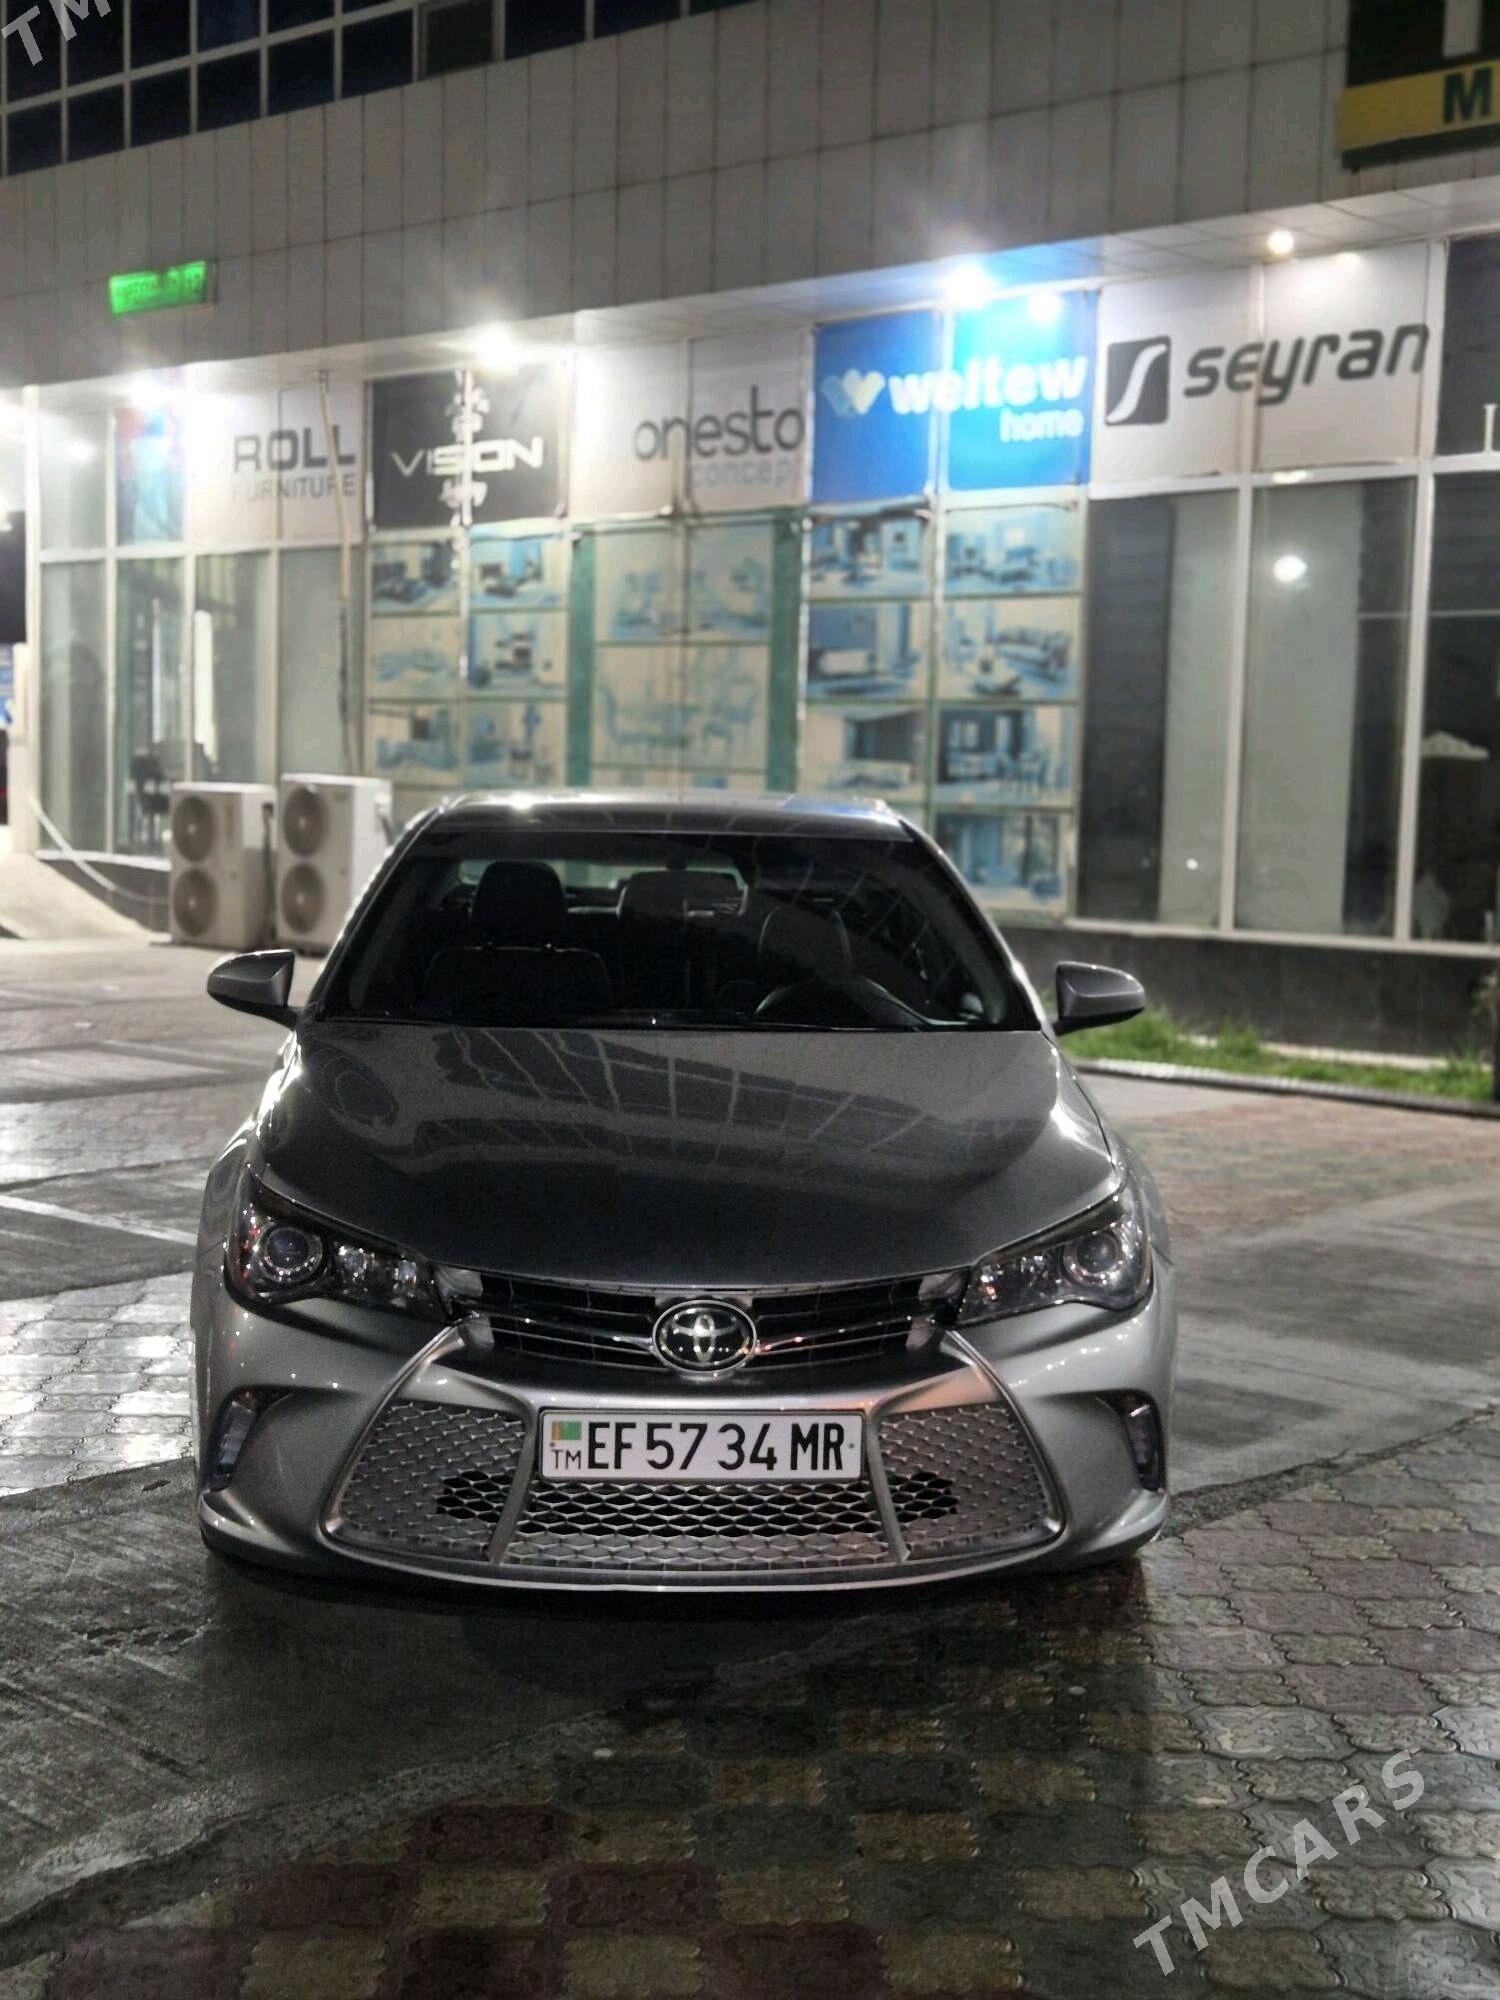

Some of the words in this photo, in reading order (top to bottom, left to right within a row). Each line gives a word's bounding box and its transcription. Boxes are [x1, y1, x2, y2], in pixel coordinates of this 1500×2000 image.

[888, 356, 1088, 415] weltew
[1184, 324, 1429, 406] seyran
[634, 385, 805, 461] onesto
[1001, 408, 1083, 442] home
[234, 424, 356, 474] ROLL
[391, 435, 544, 477] VISON
[552, 1450, 582, 1469] TM
